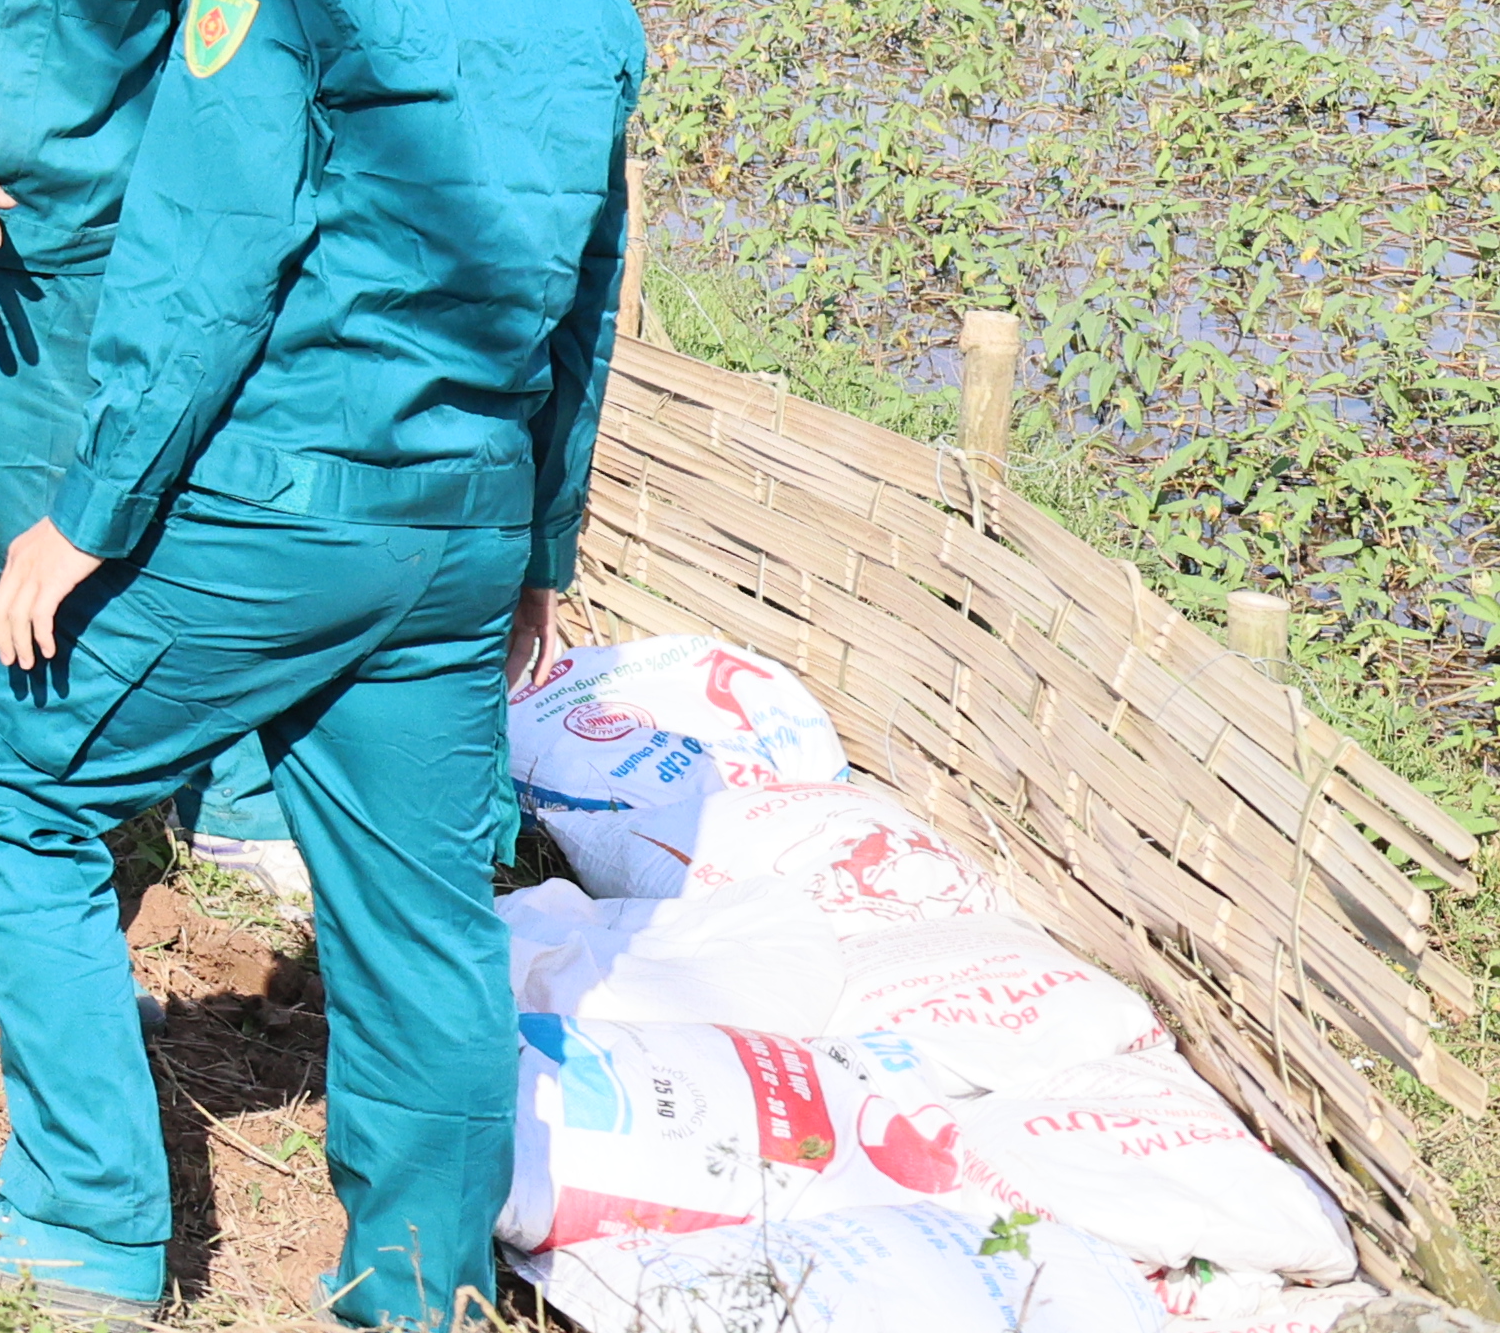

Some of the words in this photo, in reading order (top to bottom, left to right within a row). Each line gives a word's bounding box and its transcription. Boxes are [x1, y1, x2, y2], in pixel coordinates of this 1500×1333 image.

[643, 642, 689, 673] 100%
[534, 671, 610, 709] Singapore
[654, 748, 690, 783] CẤP
[900, 974, 944, 987] CAO
[1001, 969, 1090, 1005] KIM
[982, 1004, 1040, 1037] BỘT
[653, 1078, 673, 1094] 25
[685, 1082, 708, 1126] LƯỢNG
[765, 1097, 787, 1115] 30
[770, 1117, 791, 1139] KG
